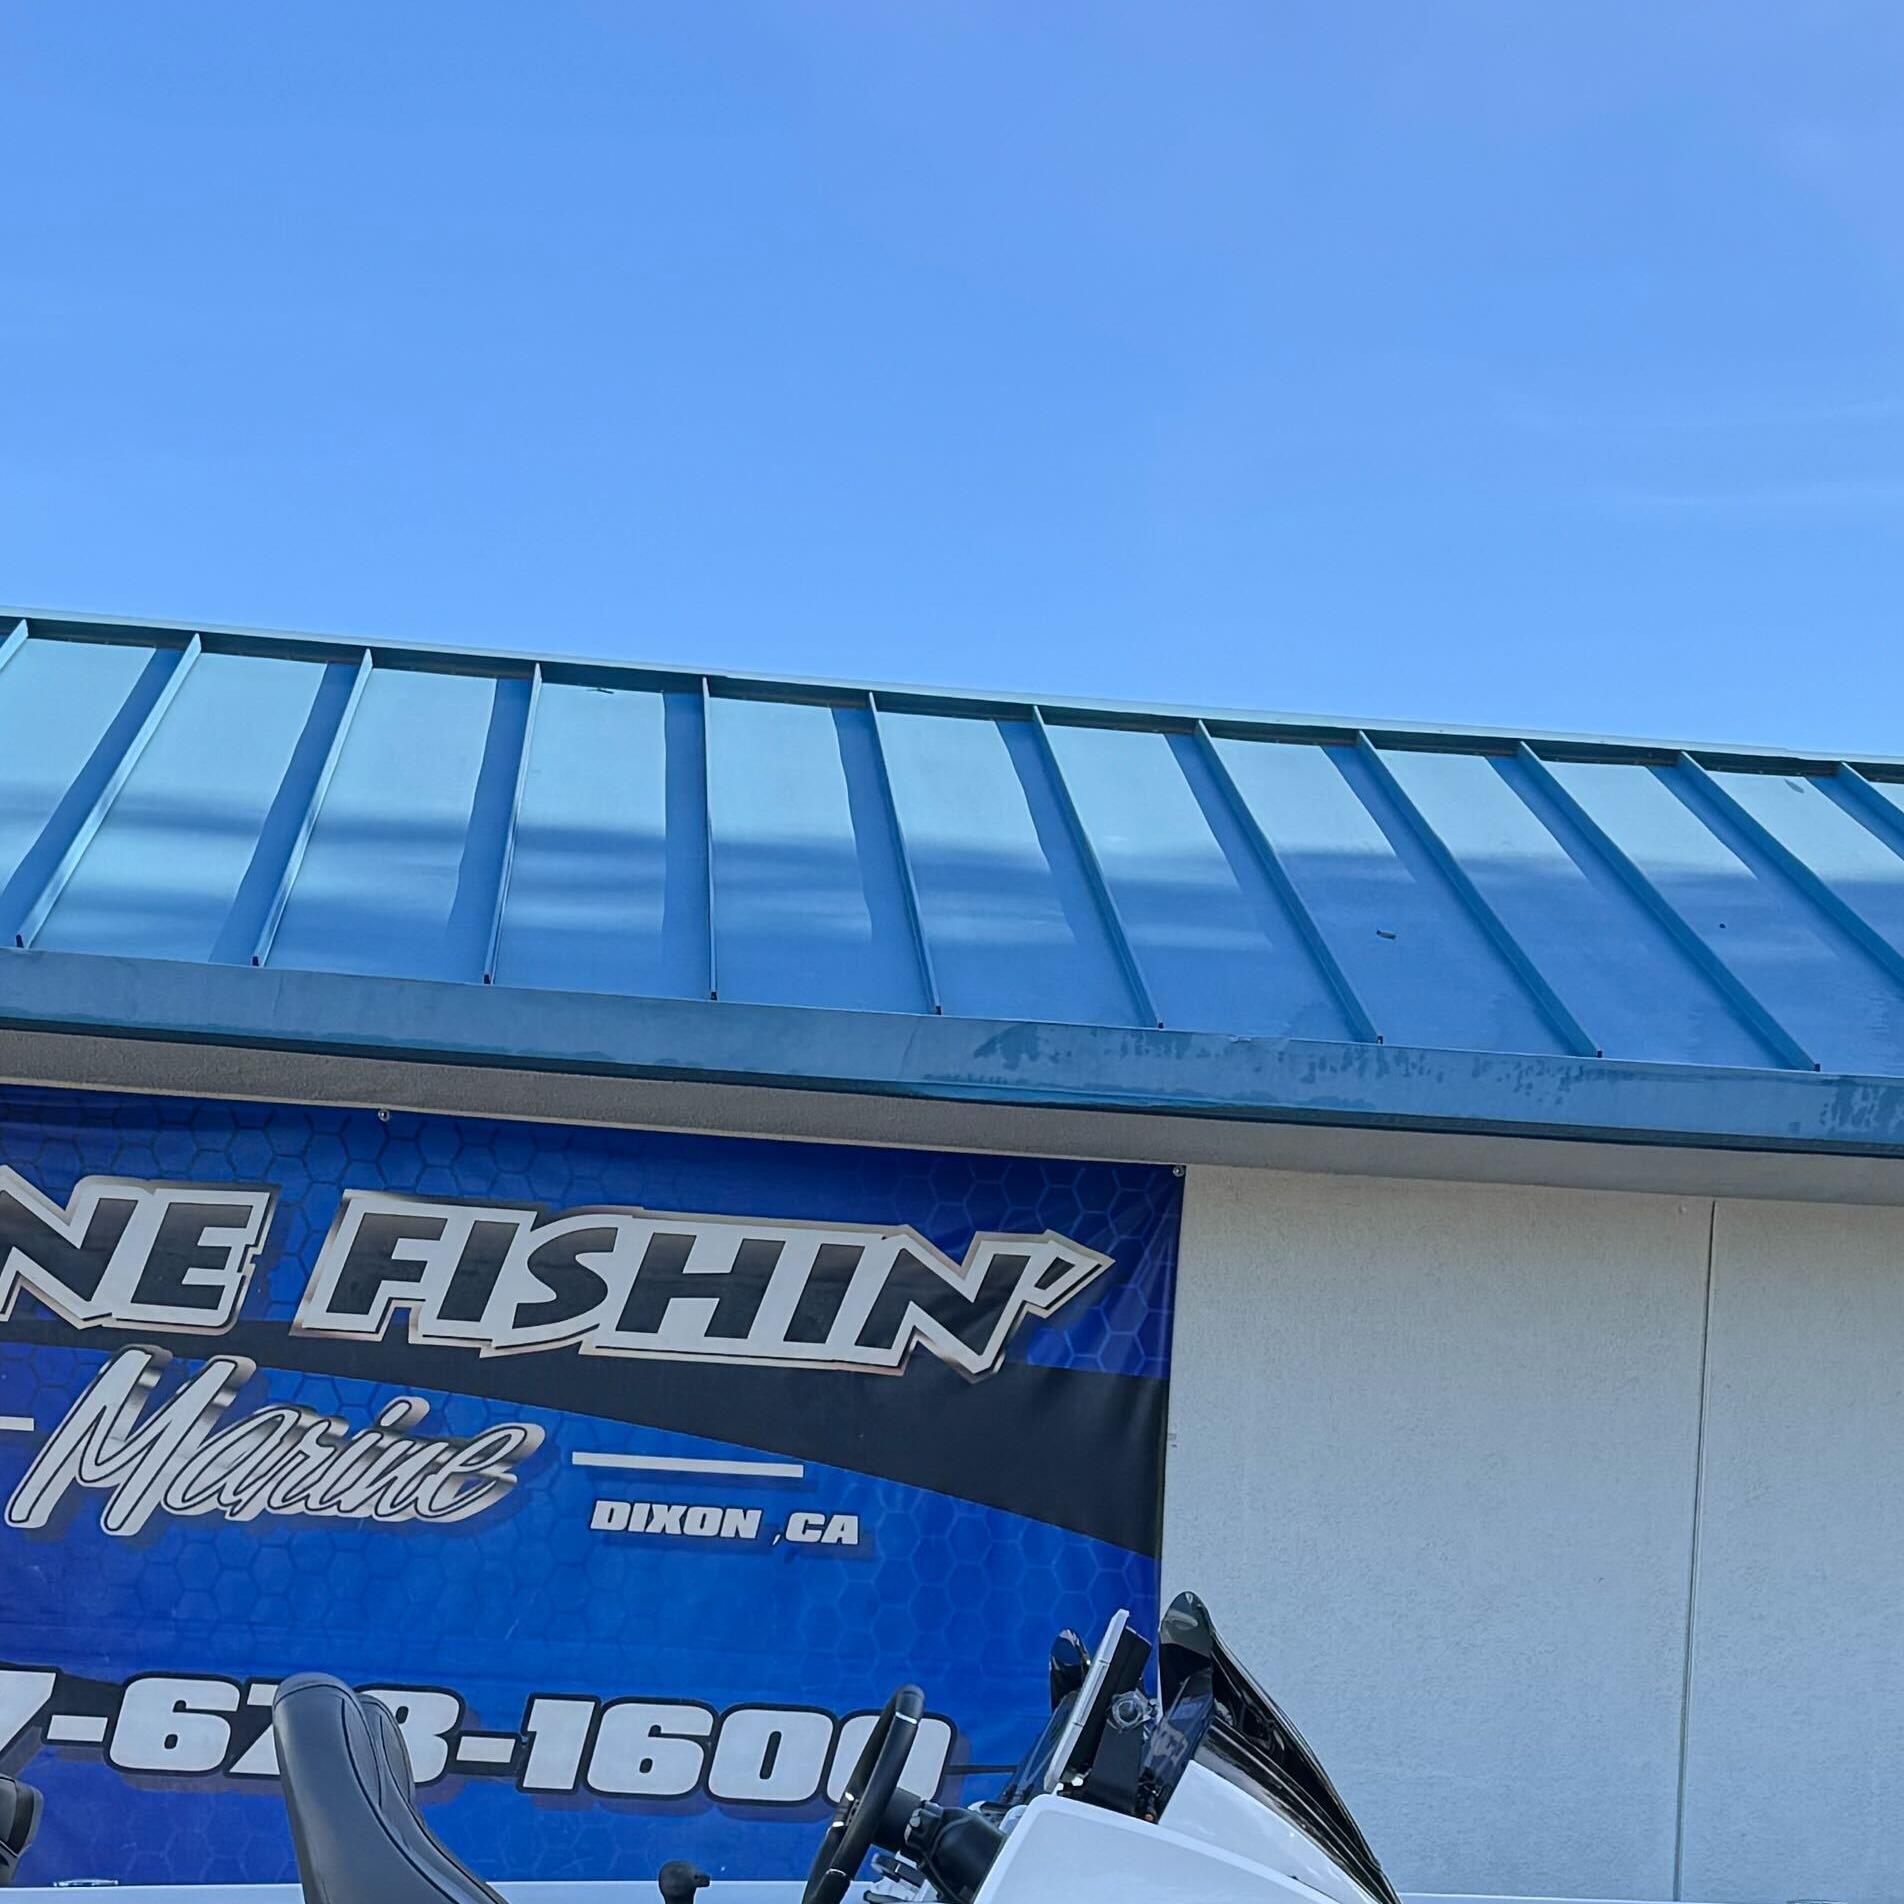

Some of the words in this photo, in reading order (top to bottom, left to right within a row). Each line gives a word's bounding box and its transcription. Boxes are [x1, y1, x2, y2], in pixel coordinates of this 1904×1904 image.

[292, 1192, 1112, 1379] FISHIN'
[4, 1344, 545, 1536] Marine
[590, 1500, 763, 1539] DIXON
